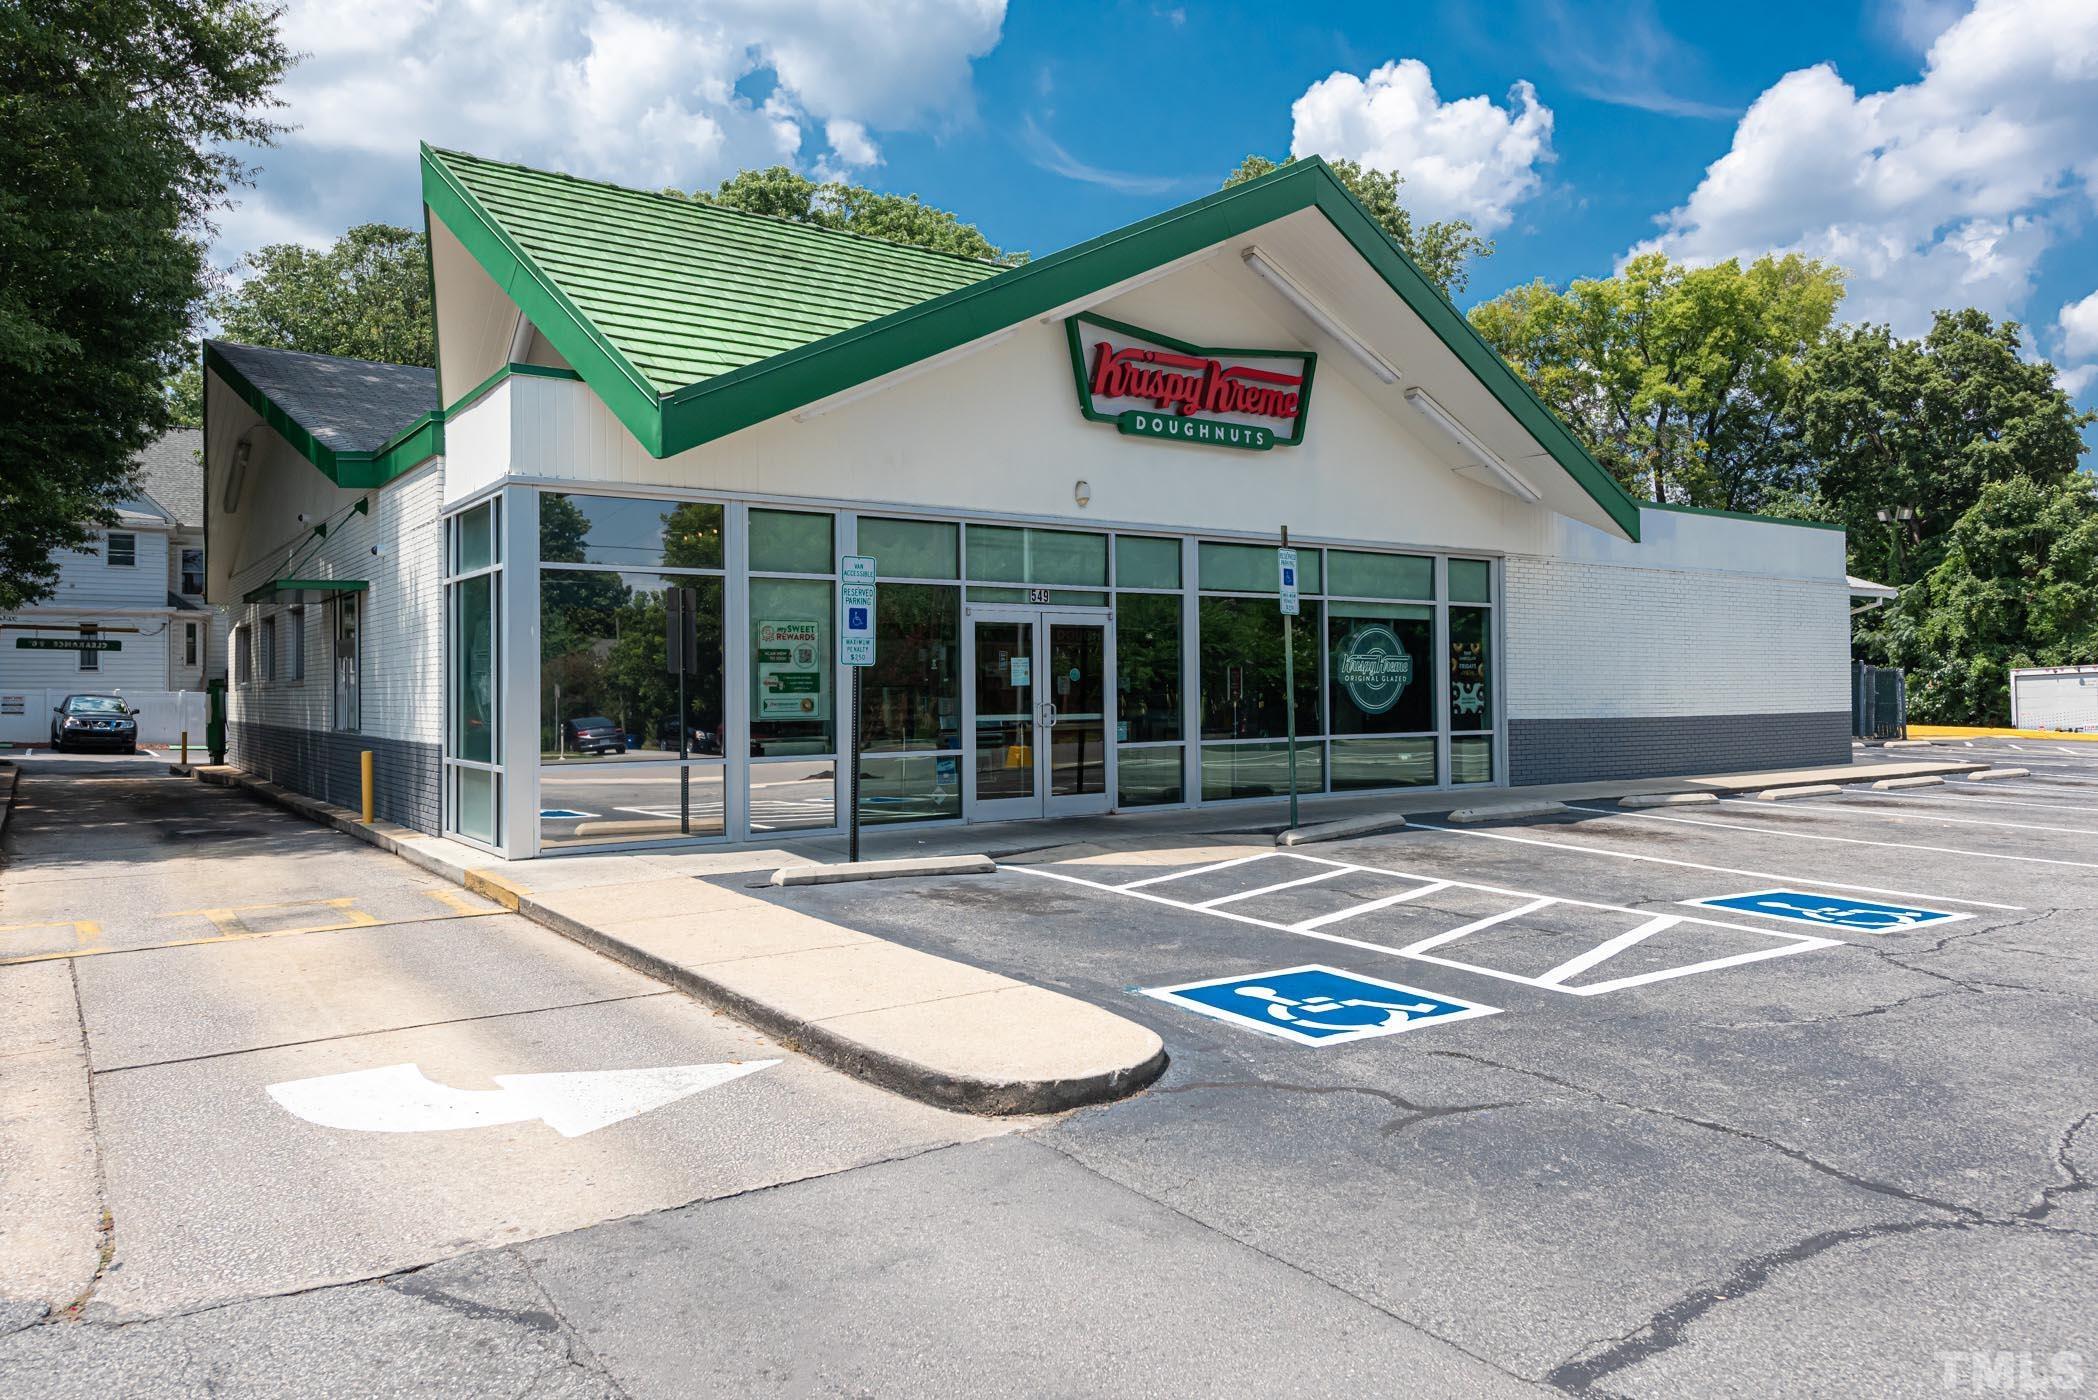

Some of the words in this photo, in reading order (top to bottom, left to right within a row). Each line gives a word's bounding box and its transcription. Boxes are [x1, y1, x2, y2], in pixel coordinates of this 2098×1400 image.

[1091, 342, 1207, 416] Krispy
[1201, 360, 1304, 418] Kreme
[1136, 416, 1264, 445] DOUGHNUTS
[844, 569, 873, 578] ACCESSIBLE
[843, 588, 873, 597] RESERVED
[1031, 590, 1049, 602] 549
[845, 597, 872, 605] PARKING
[776, 633, 815, 641] REWARDS
[1342, 653, 1378, 675] Krispy
[1373, 655, 1410, 674] Kreme
